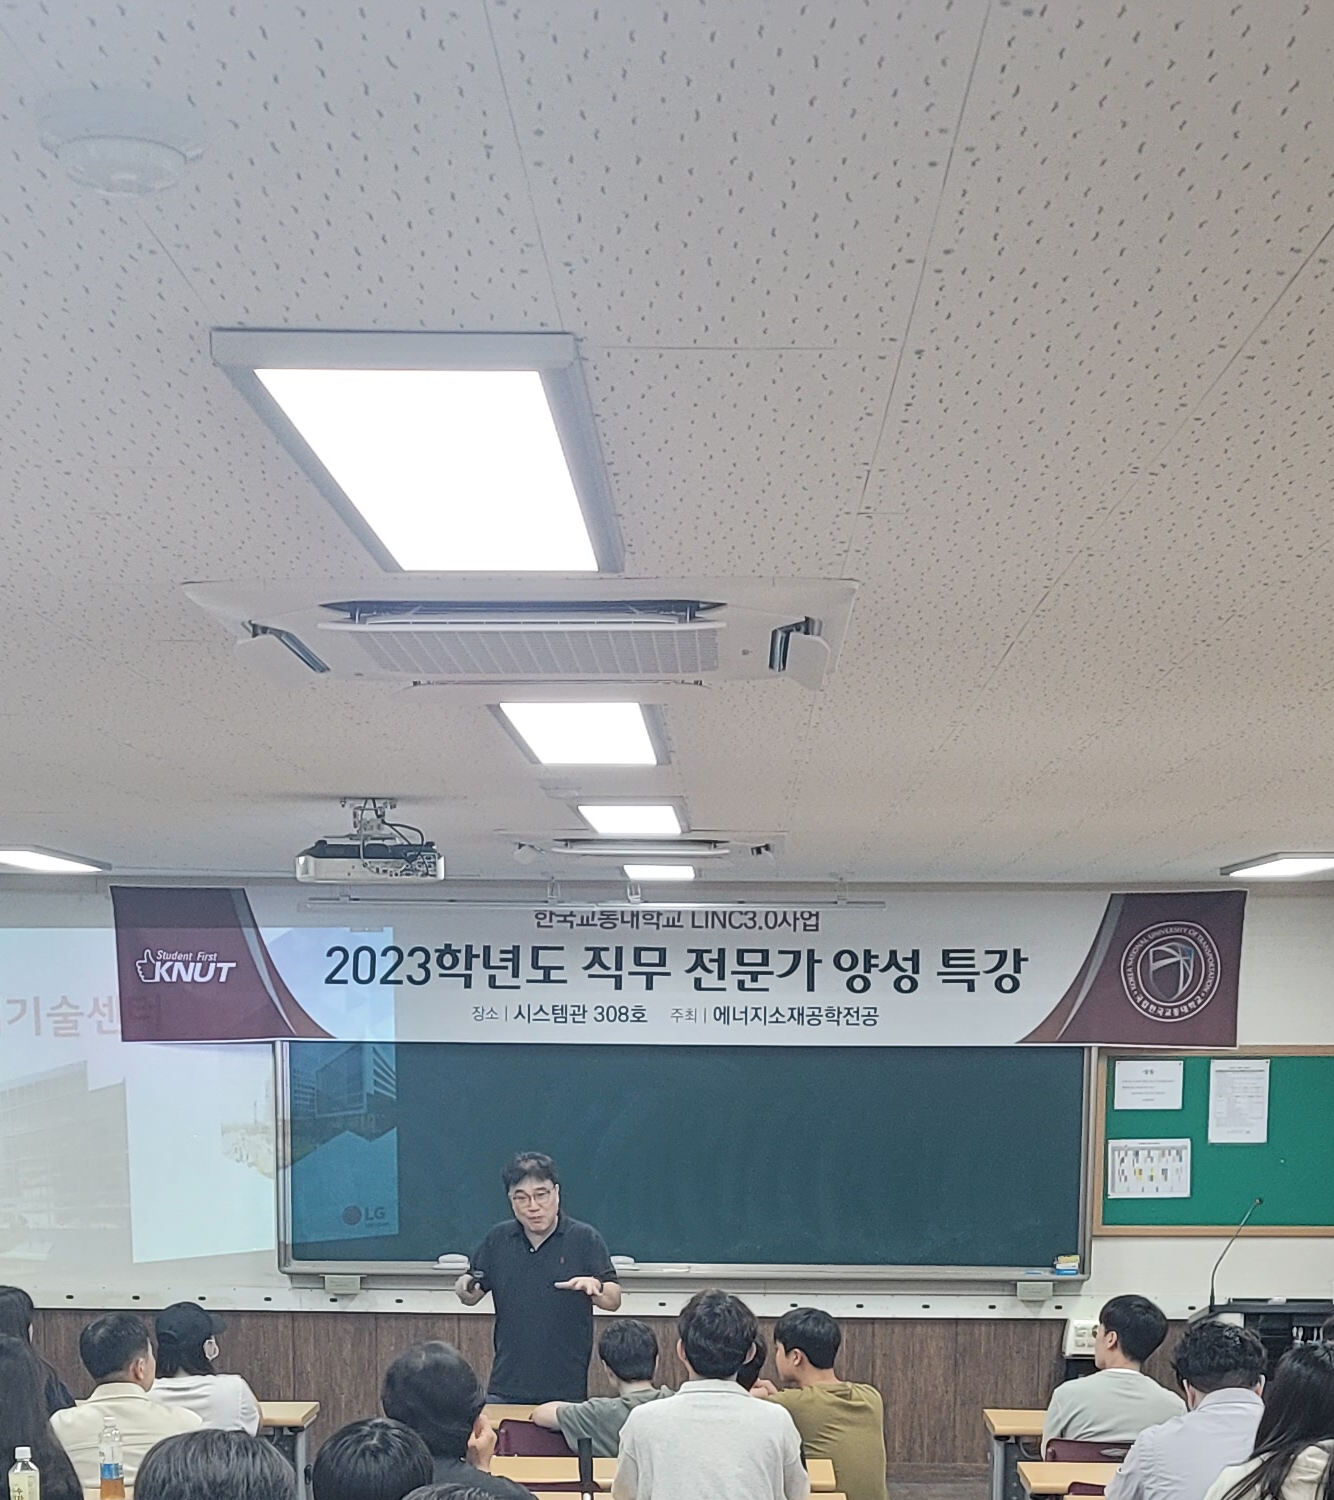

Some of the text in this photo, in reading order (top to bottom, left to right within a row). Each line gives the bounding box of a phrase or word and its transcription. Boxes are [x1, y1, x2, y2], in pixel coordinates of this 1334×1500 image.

[691, 910, 821, 932] LINC3.0사업
[156, 950, 218, 962] Student First
[155, 961, 237, 982] KNUT
[324, 942, 1029, 994] 2023학년도 직무 전문가 양성 특강
[471, 1003, 880, 1028] 장소 시스템관 308호 주최 에너지소재공학전공
[364, 1206, 386, 1221] LG
